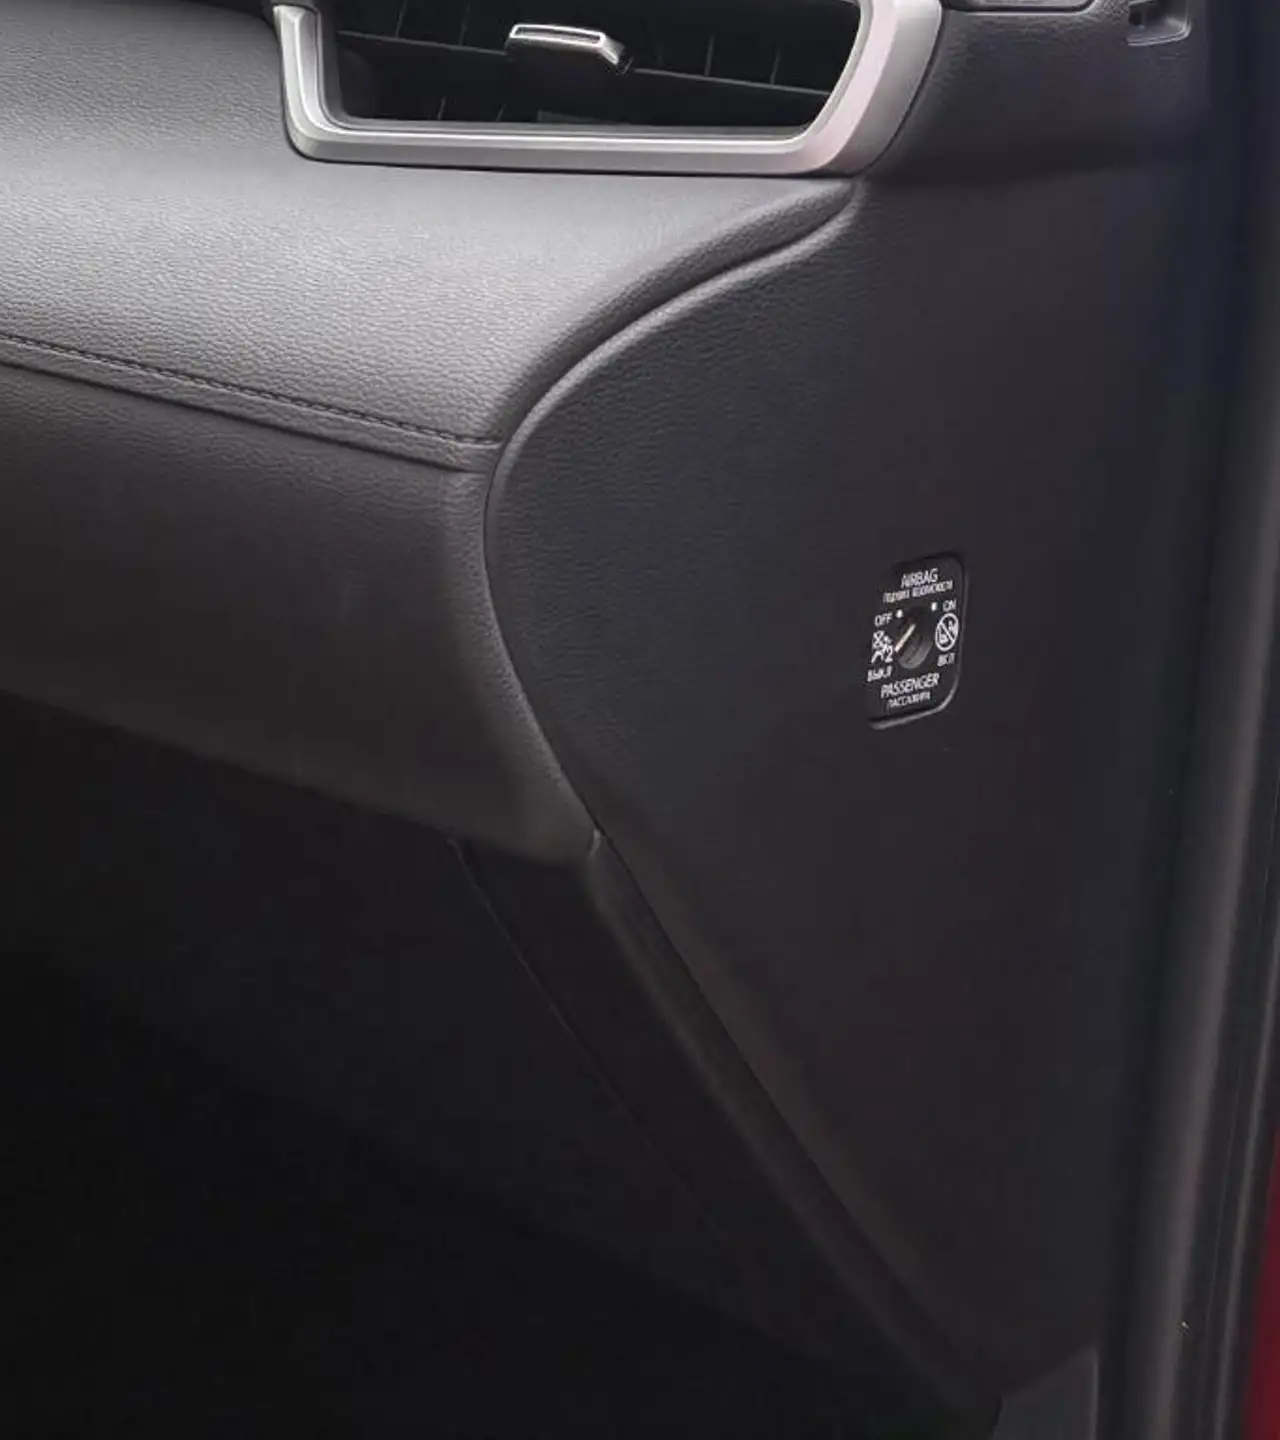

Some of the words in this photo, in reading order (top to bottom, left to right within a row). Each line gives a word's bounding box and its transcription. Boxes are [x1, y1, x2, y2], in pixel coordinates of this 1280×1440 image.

[900, 568, 939, 588] AIRBAG
[942, 599, 957, 612] ON
[874, 613, 893, 627] OFF
[881, 673, 940, 698] PASSENGER
